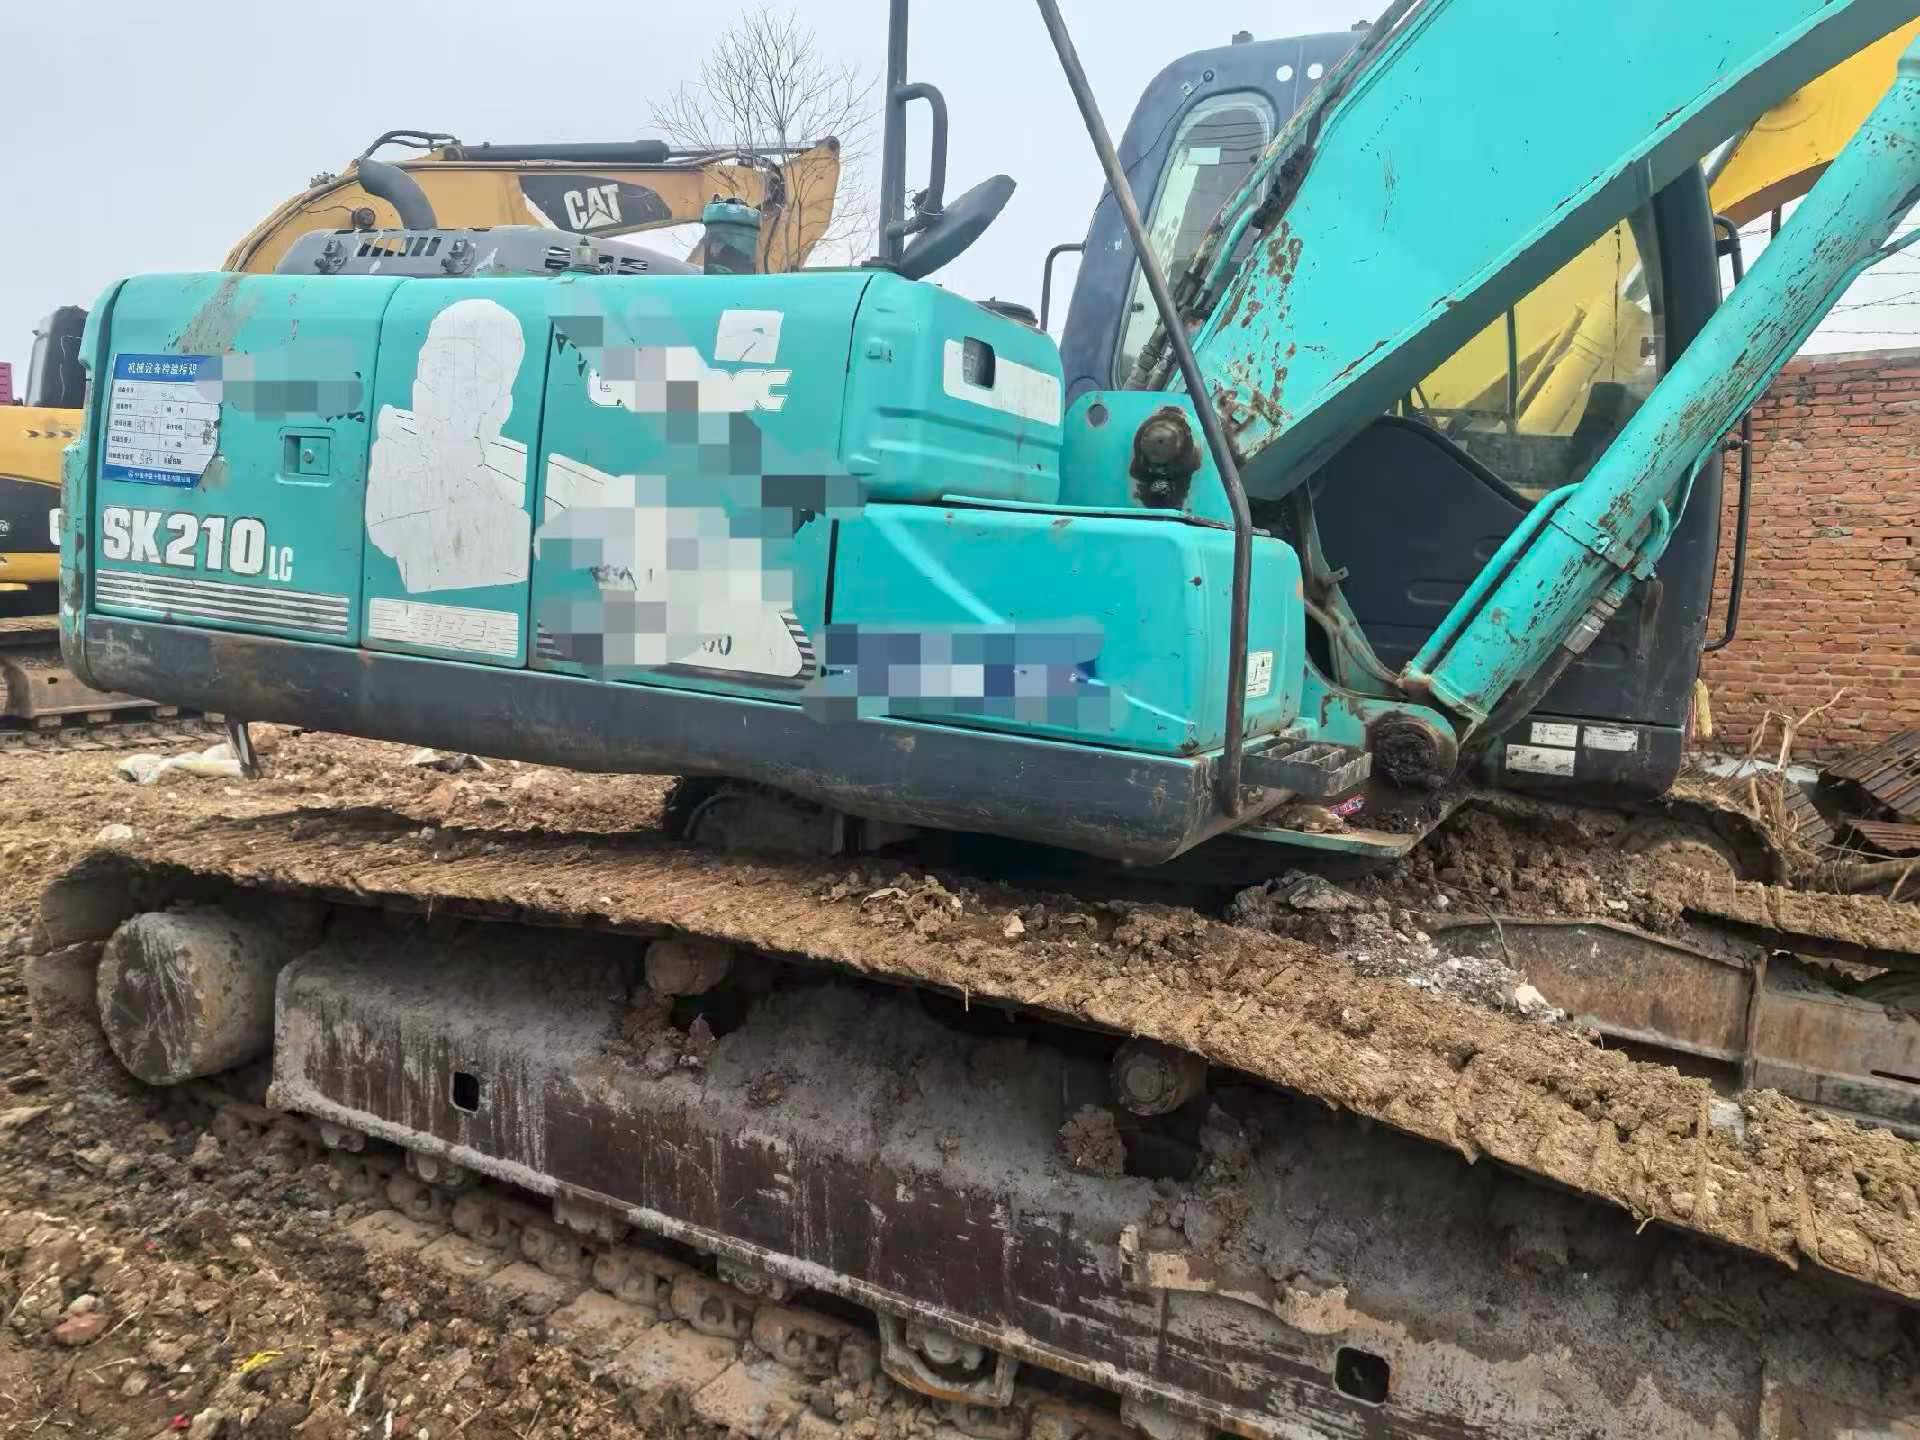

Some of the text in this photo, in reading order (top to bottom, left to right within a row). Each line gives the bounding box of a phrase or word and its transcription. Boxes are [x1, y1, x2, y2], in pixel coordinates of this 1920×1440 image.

[563, 183, 622, 230] CAT
[103, 506, 267, 576] SK210
[268, 545, 294, 582] LC
